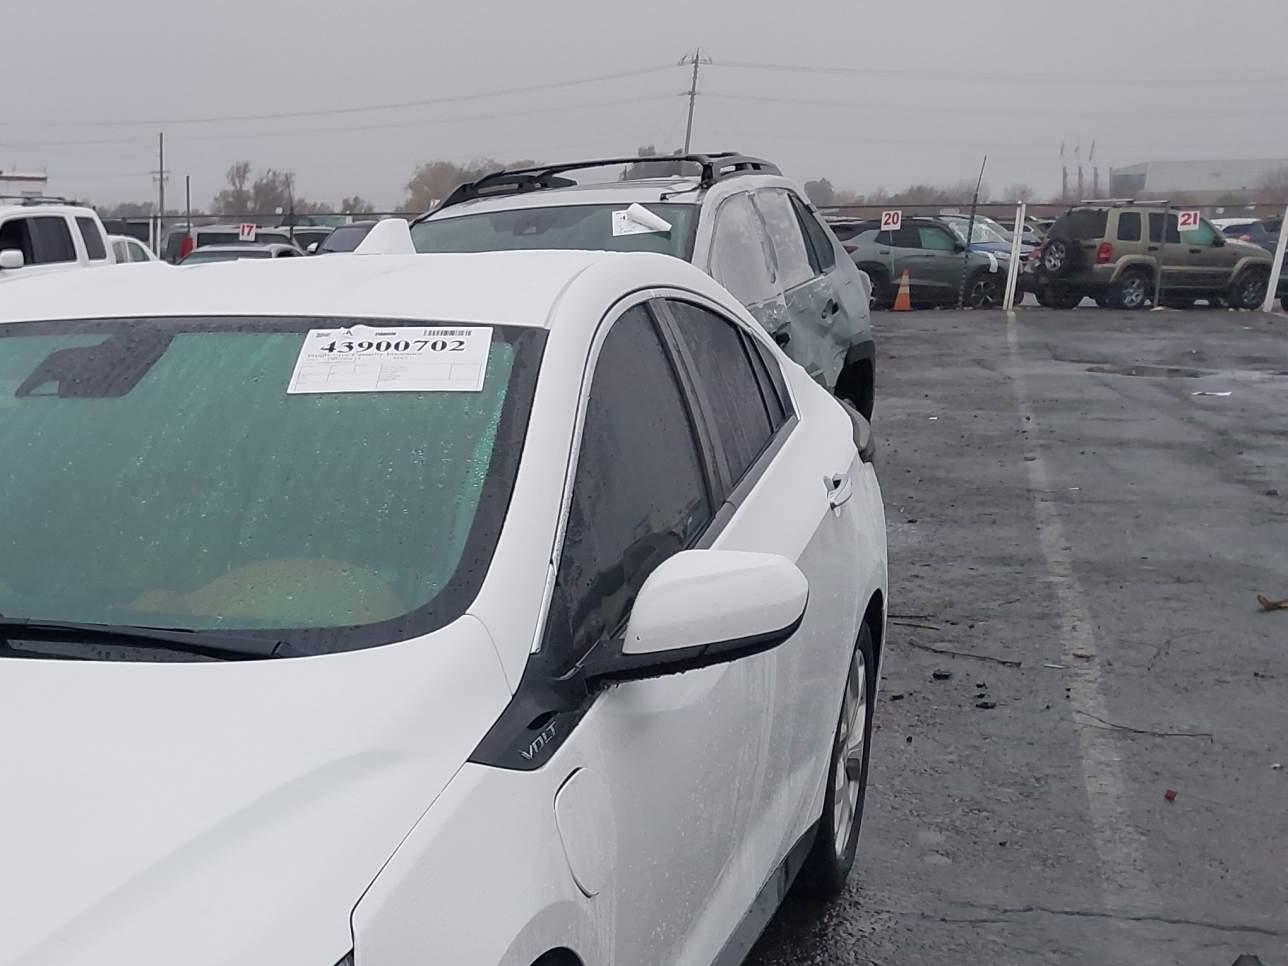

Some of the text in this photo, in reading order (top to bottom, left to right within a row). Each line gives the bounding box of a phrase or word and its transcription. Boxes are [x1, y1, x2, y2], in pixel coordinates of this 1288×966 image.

[884, 212, 900, 225] 20
[1180, 212, 1198, 226] 21
[241, 224, 254, 236] 17
[320, 340, 465, 353] 43900702
[518, 720, 556, 760] VOLT
